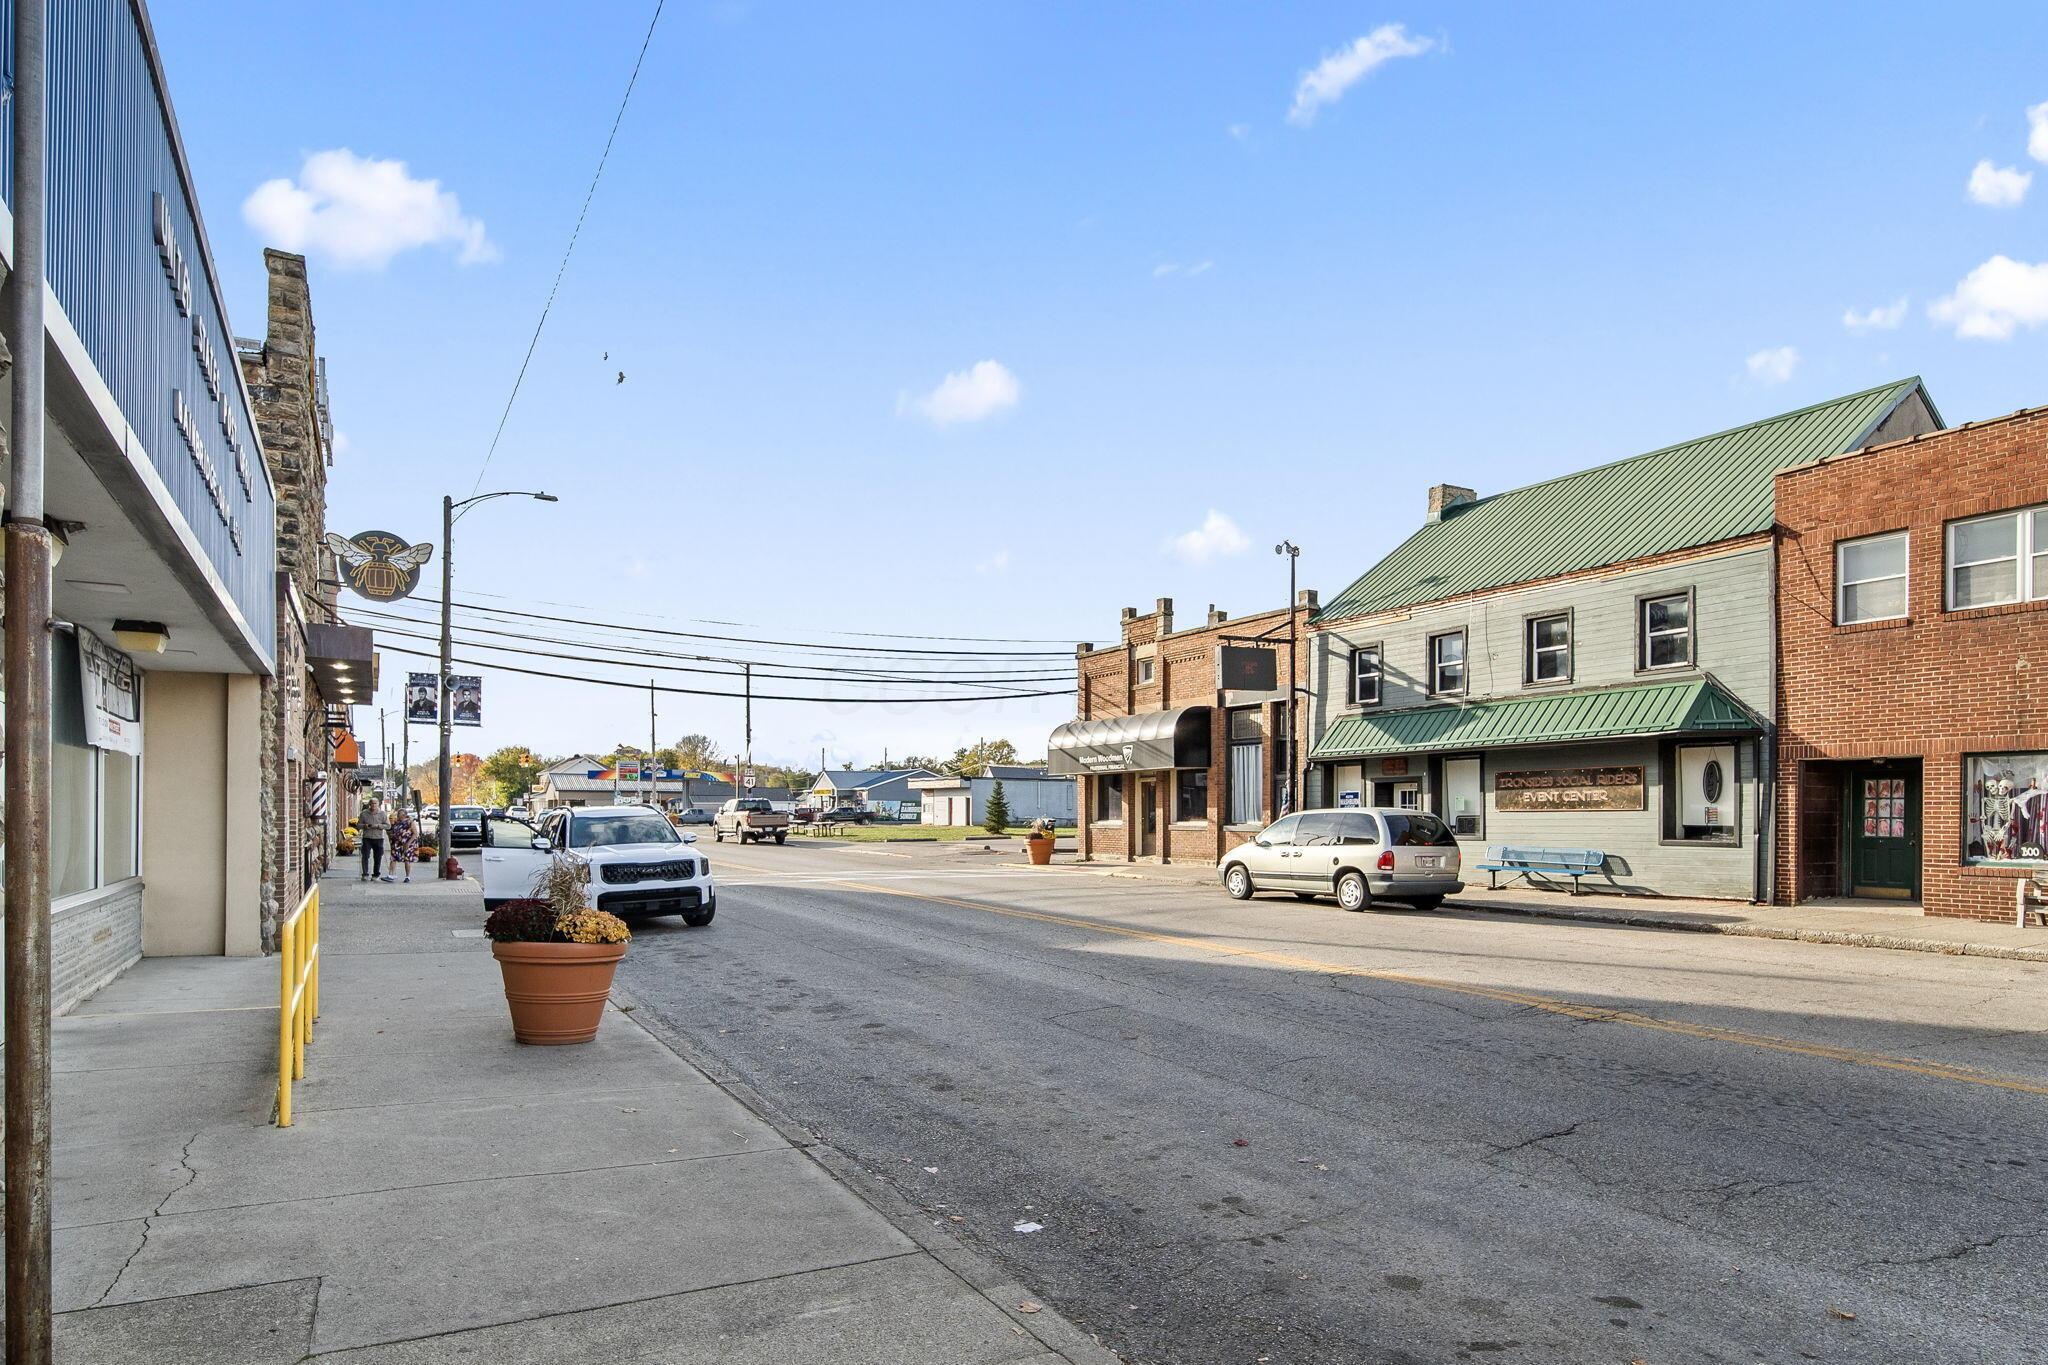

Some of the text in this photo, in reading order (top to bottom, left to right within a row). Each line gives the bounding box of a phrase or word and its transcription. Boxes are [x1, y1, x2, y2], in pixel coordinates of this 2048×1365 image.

[154, 192, 191, 318] UNITED
[193, 315, 219, 402] STATES
[1079, 754, 1123, 764] Modern Woodmen
[745, 778, 754, 786] 41
[1499, 771, 1638, 788] IRONSIDES SOCIAL RIDERS
[1523, 789, 1609, 802] EVENT CENTER
[2021, 846, 2040, 857] BOO
